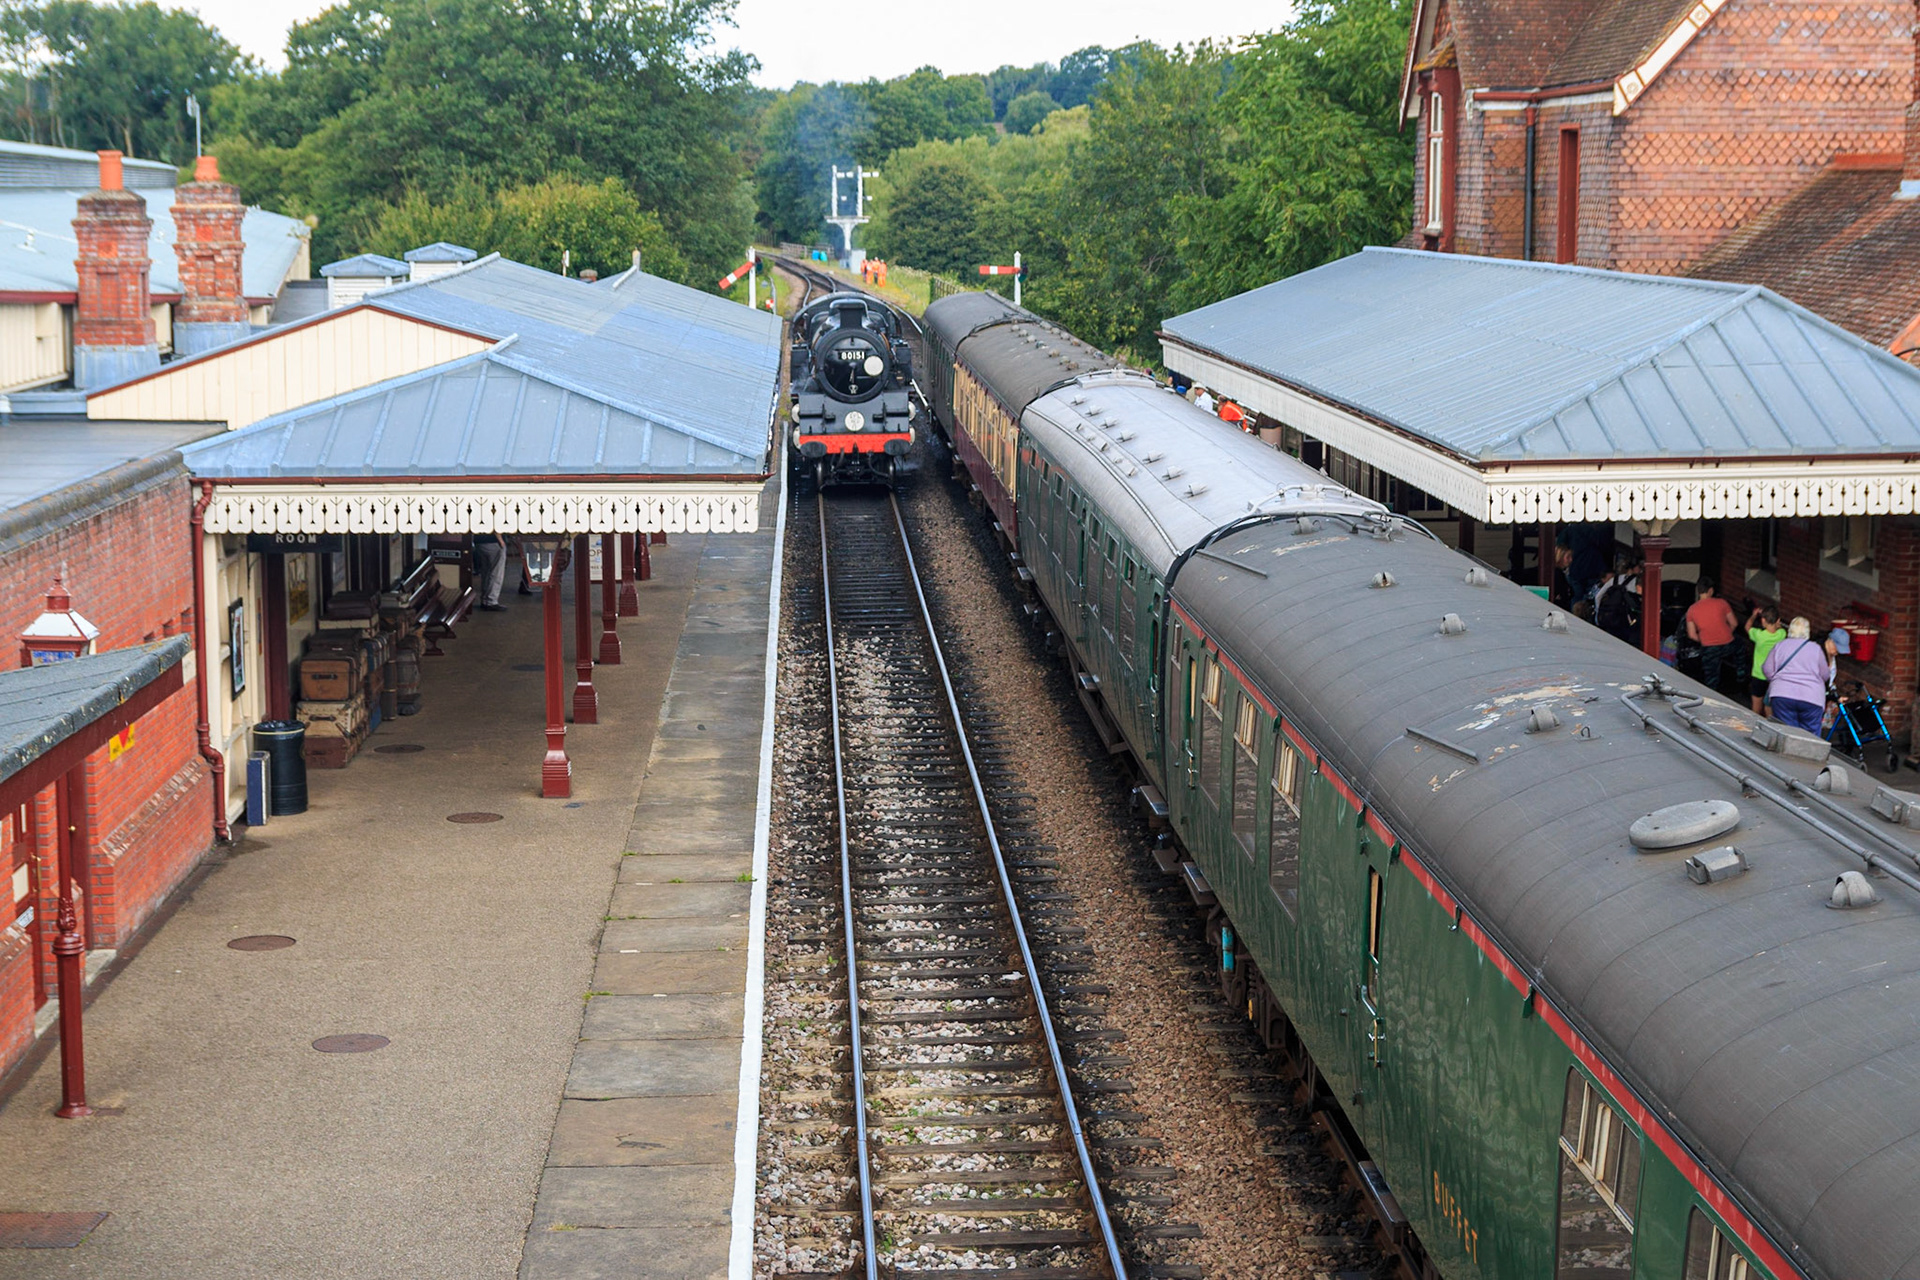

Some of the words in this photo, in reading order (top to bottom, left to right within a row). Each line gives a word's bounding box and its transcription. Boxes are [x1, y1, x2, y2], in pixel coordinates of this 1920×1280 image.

[841, 351, 865, 360] 80151
[275, 533, 317, 544] ROOM
[1433, 1170, 1478, 1265] BUFFET
